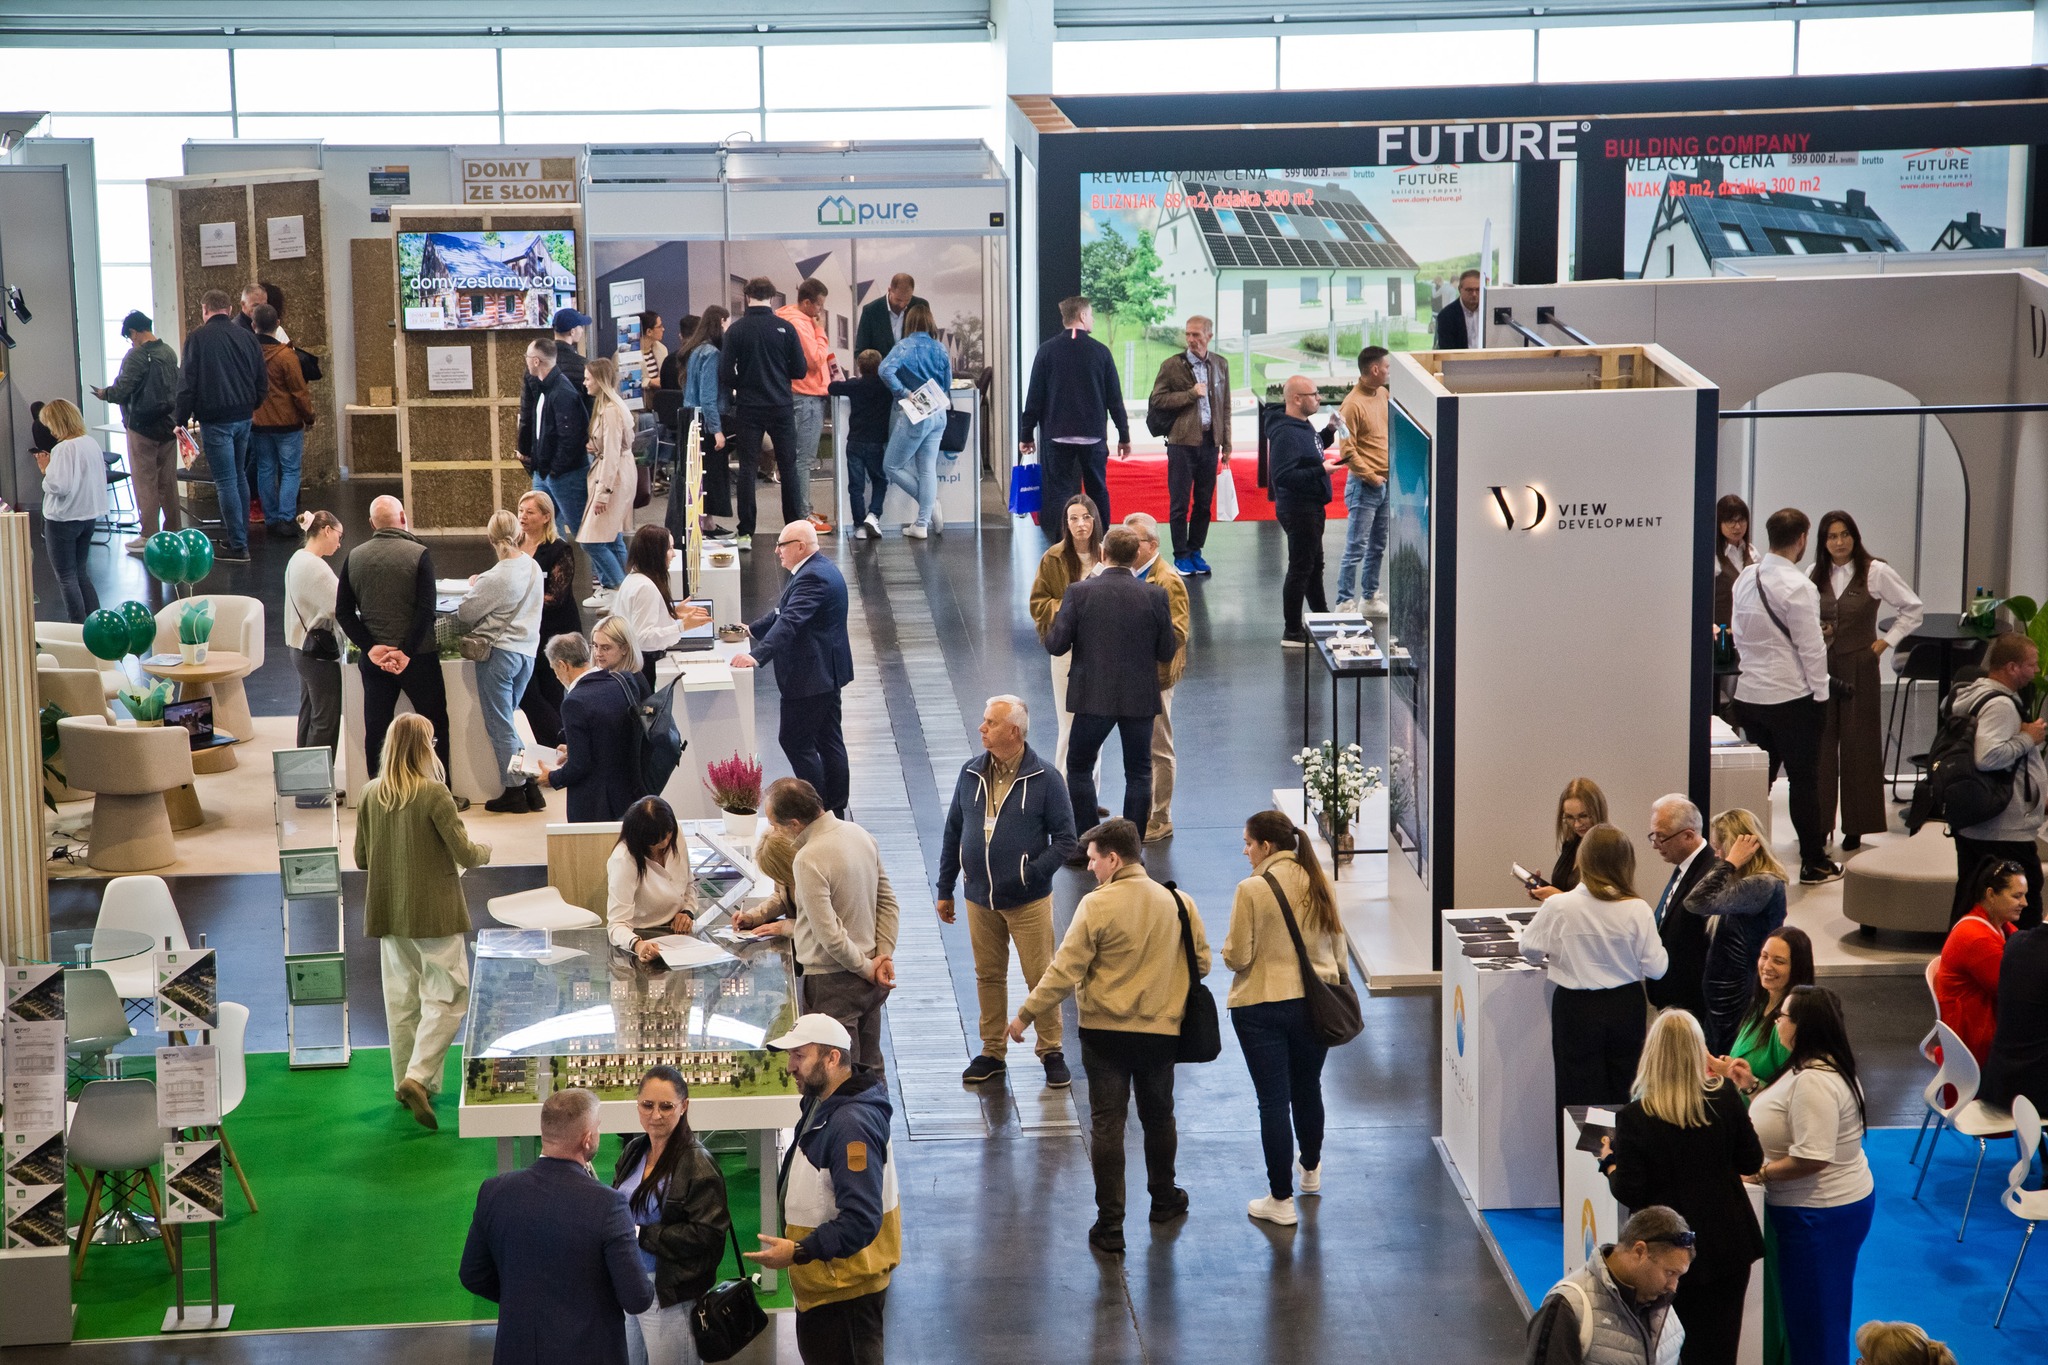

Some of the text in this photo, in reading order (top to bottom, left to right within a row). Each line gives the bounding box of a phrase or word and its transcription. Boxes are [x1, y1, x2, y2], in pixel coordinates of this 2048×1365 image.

[1605, 136, 1699, 158] BULDING
[1706, 133, 1810, 154] COMPANY
[1729, 154, 1775, 169] CENA
[1791, 154, 1807, 164] 599
[1809, 153, 1826, 164] 000
[1862, 155, 1884, 165] brutto
[1908, 158, 1970, 172] FUTURE
[467, 162, 530, 178] DOMY
[1285, 168, 1300, 178] 599
[1353, 169, 1375, 179] brutto
[1398, 172, 1458, 186] FUTURE
[1901, 180, 1973, 190] www.domy-future.pl
[469, 184, 570, 200] ZE SŁOMY
[1669, 180, 1686, 197] 88
[1770, 177, 1796, 194] 300
[1800, 176, 1821, 192] m2
[1165, 193, 1181, 209] 88
[1264, 189, 1290, 207] 300
[1293, 188, 1315, 206] m2
[1392, 195, 1463, 204] www.domy-future.pl
[859, 202, 919, 225] pure
[410, 273, 570, 291] domyzeslomy.com
[624, 292, 643, 303] pure
[1558, 503, 1607, 517] VIEW
[1558, 516, 1663, 530] DEVELOPMENT
